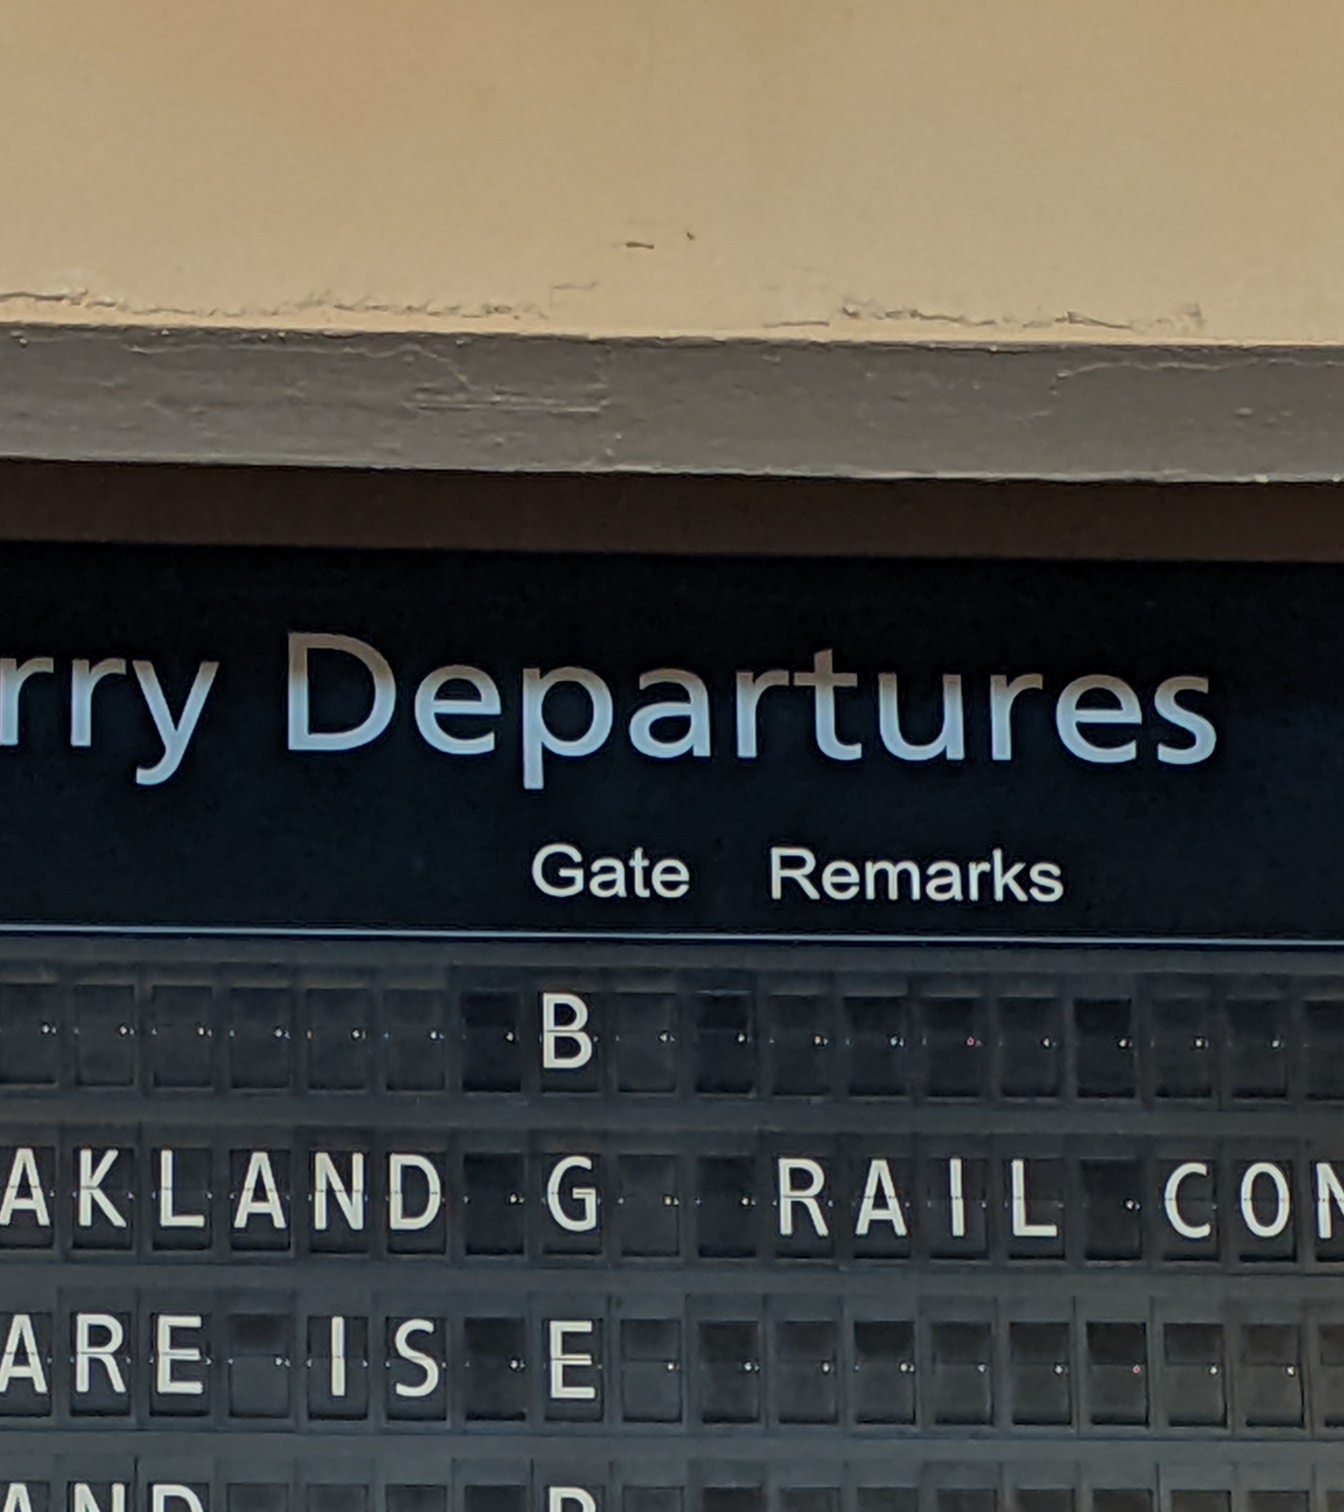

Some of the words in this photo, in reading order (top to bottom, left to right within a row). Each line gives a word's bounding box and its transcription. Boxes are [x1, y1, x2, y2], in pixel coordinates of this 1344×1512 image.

[286, 632, 1218, 791] Departures
[531, 843, 691, 899] Gate
[770, 846, 1064, 903] Remarks
[542, 991, 593, 1069] B
[546, 1155, 598, 1232] G
[777, 1157, 1058, 1238] RAIL
[330, 1315, 440, 1398] IS
[548, 1319, 597, 1400] E
